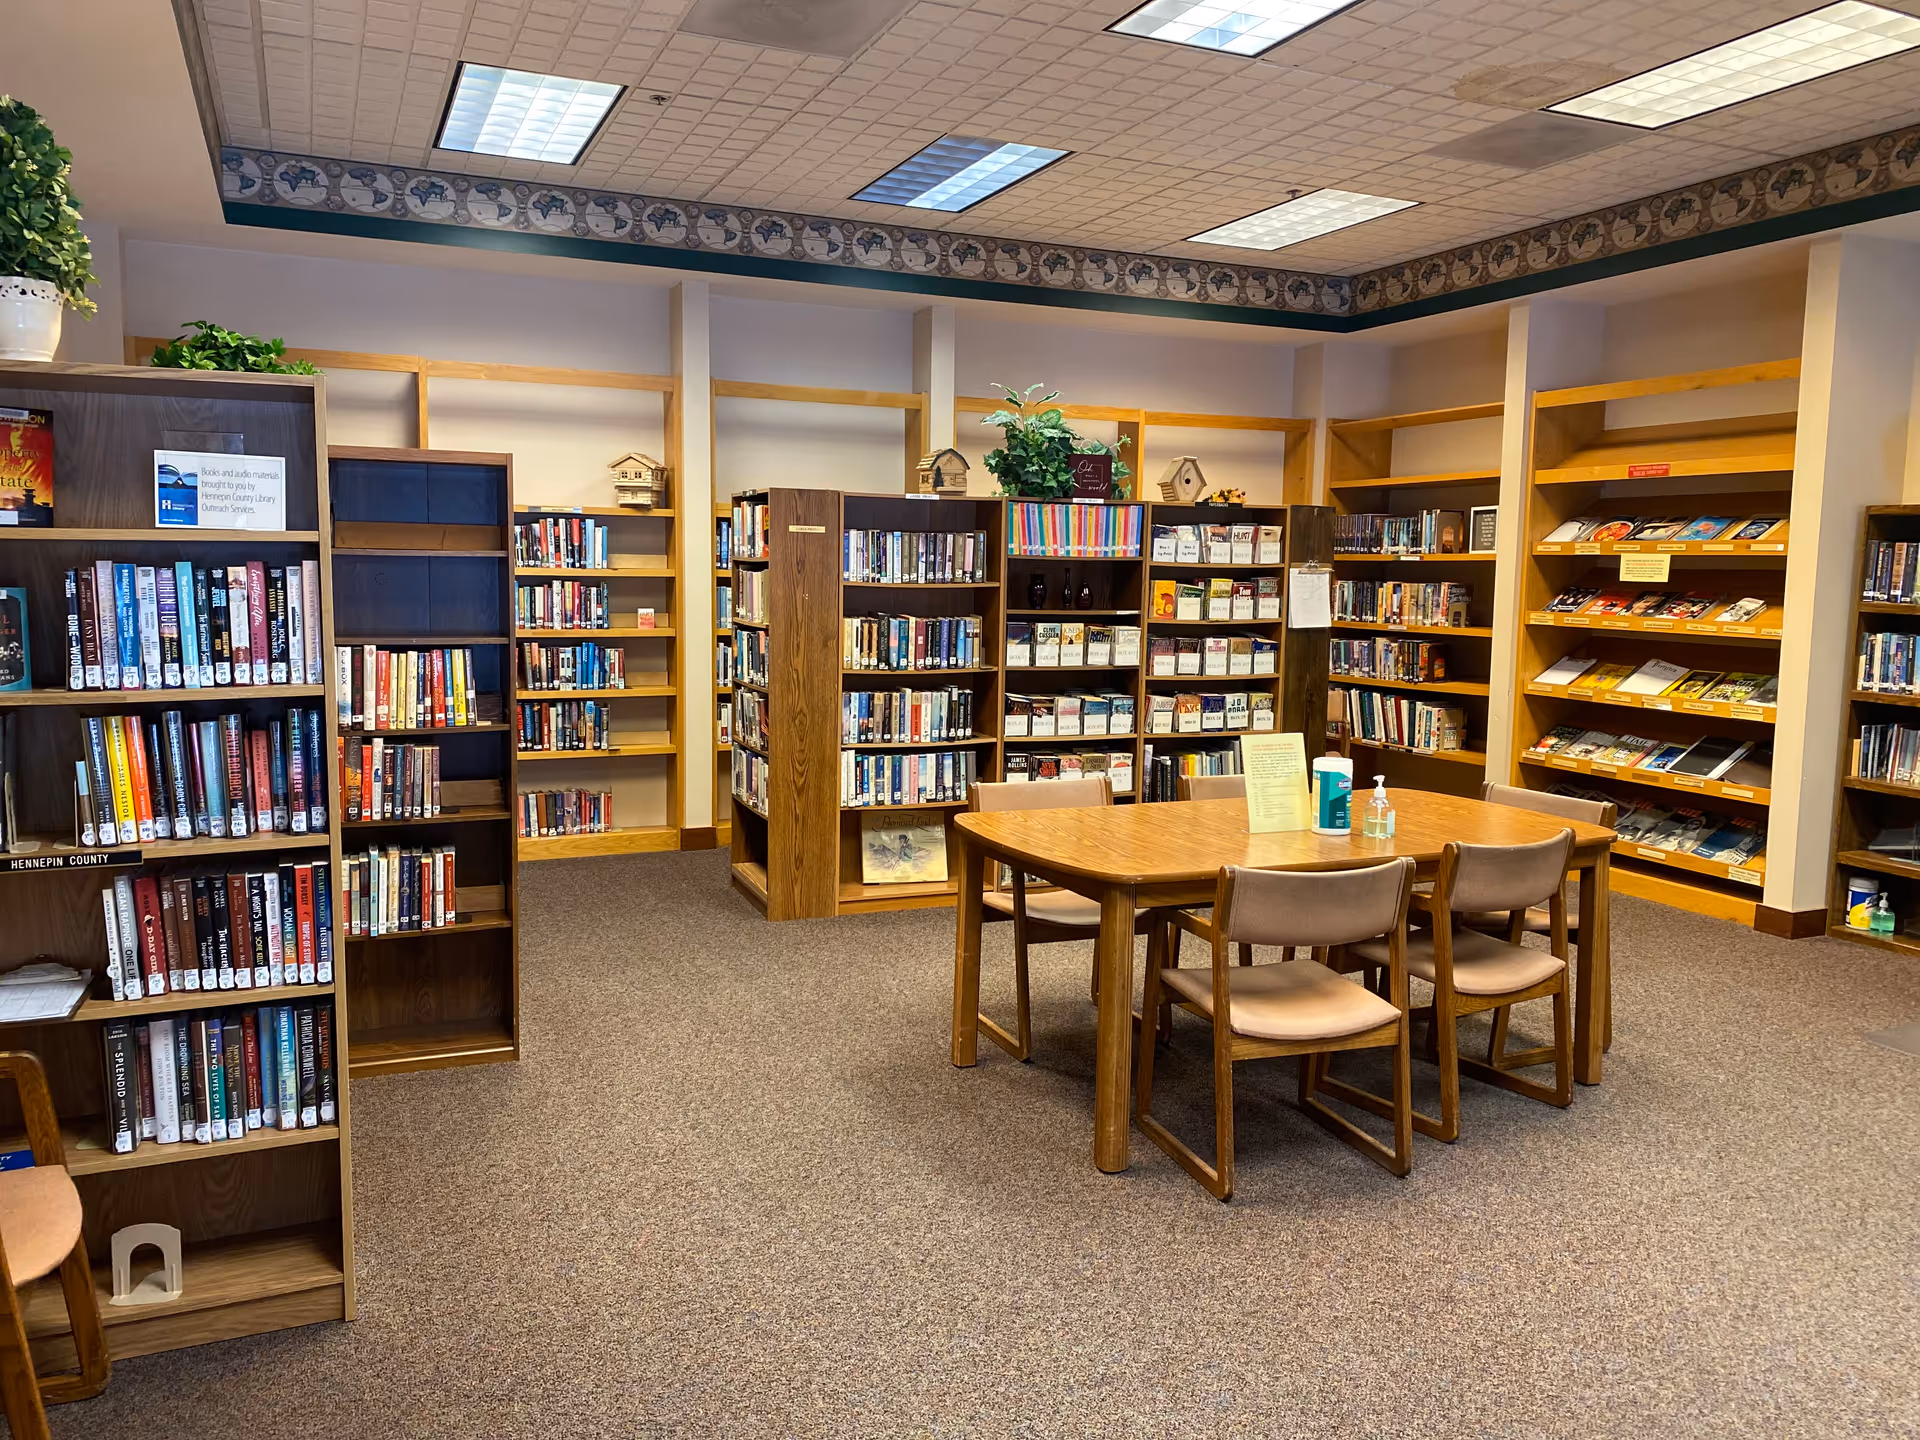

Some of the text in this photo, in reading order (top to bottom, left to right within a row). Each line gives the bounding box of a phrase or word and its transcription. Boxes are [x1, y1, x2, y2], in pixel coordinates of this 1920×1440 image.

[202, 468, 220, 476] Books
[202, 481, 225, 489] brought
[248, 482, 255, 491] by
[202, 492, 275, 504] Hennepin County Library
[202, 504, 229, 512] Outreach
[122, 569, 130, 603] BRIDGERTON
[159, 580, 177, 627] THIN ICE
[212, 587, 220, 608] JEWEL
[250, 569, 263, 627] Everything After
[68, 614, 79, 636] GONE
[84, 619, 93, 639] EASY
[198, 613, 207, 623] The
[270, 620, 278, 659] ROSENBERG
[1626, 736, 1650, 746] TIME
[225, 729, 242, 800] DAVID BALDACCI
[292, 729, 302, 793] WERE NEVER HERE
[175, 780, 186, 802] DEADLY
[121, 790, 129, 818] NESTOR
[11, 854, 109, 869] HENNEPIN COUNTY
[300, 874, 308, 884] TIM
[317, 868, 327, 923] STUART WOODS
[252, 896, 262, 919] NIGHT'S
[117, 881, 136, 979] MEGAN RAPINOE ONE LIF
[254, 920, 262, 932] TAIL
[284, 907, 292, 932] WOMAN
[302, 921, 310, 939] TROPIC
[146, 927, 154, 953] D-DAY
[166, 930, 174, 956] SUMMER
[270, 924, 280, 950] WITHOUT
[303, 940, 310, 948] OF
[256, 952, 264, 965] KELLY
[285, 941, 294, 958] LIGHT
[320, 1011, 328, 1039] STUART
[280, 1011, 290, 1077] JONATHAN KELLERMAN
[301, 1015, 314, 1079] PATRICIA CORNWELL
[179, 1042, 189, 1081] DROWNING
[115, 1052, 125, 1098] SPLENDID
[182, 1082, 190, 1096] SEA
[213, 1094, 219, 1102] OF
